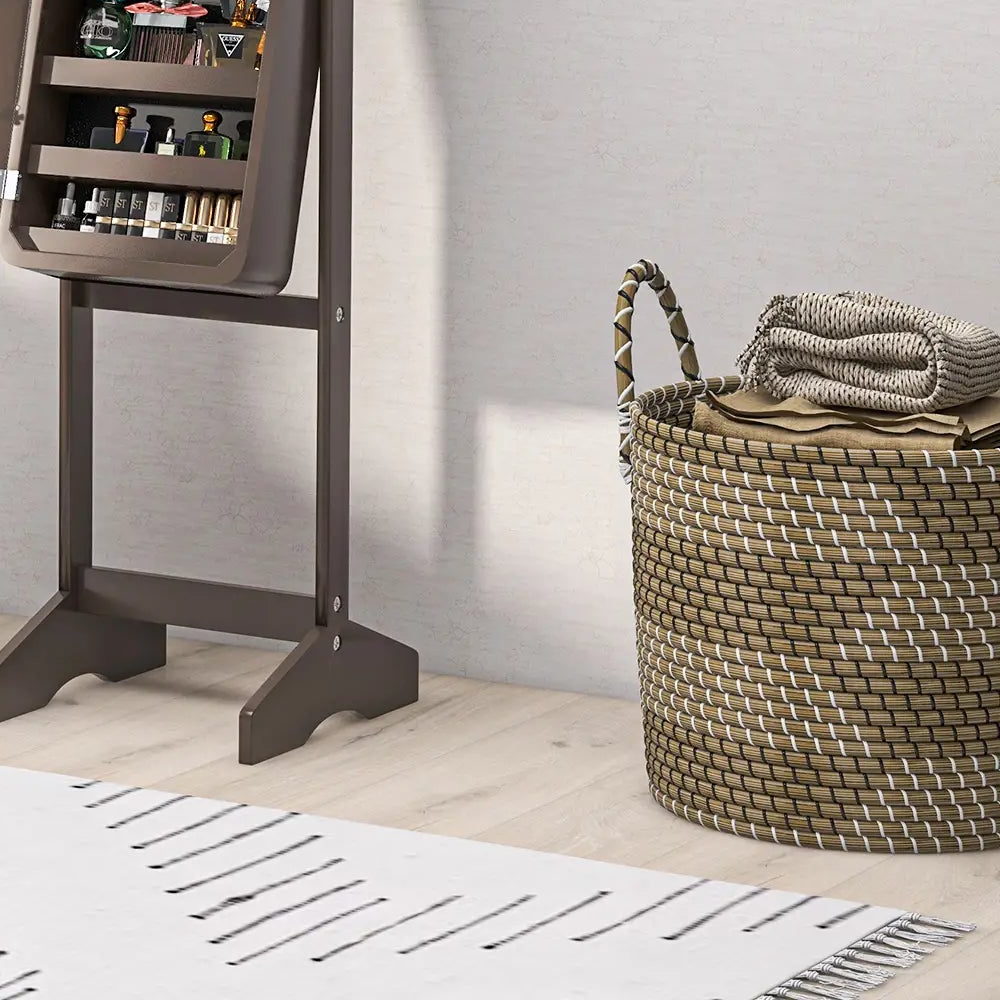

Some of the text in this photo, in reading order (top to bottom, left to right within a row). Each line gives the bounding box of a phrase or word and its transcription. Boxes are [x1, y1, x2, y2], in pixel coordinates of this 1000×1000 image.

[100, 197, 111, 208] ST
[116, 199, 127, 209] ST
[132, 200, 144, 210] ST
[149, 201, 160, 211] ST
[165, 203, 175, 213] ST
